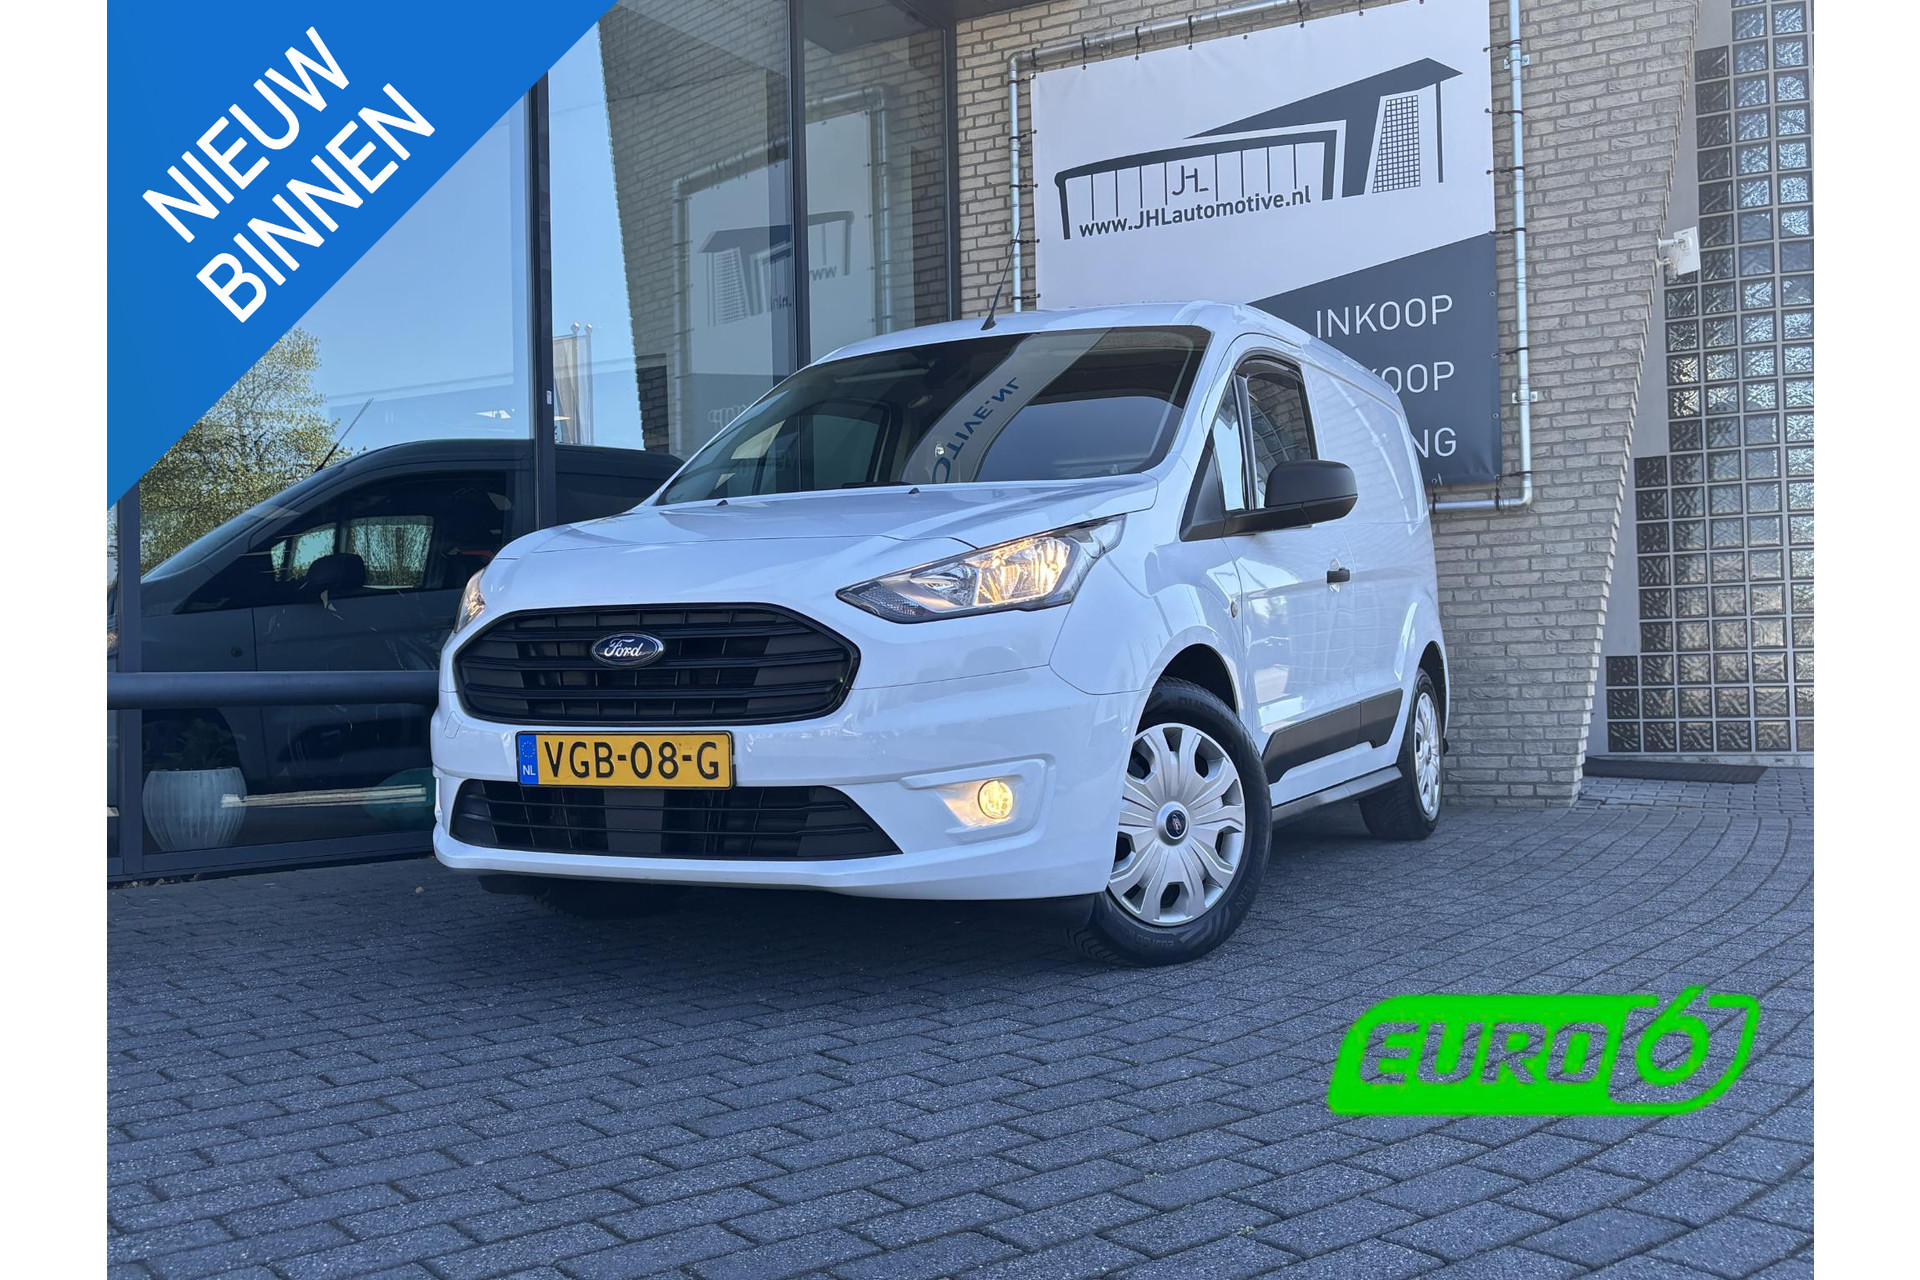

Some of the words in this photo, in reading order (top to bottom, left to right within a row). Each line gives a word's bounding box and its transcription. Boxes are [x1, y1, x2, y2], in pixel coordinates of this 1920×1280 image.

[1079, 185, 1312, 238] www.JHLautomotive.nl
[1316, 294, 1453, 339] INKOOP
[1371, 361, 1455, 394] OOP
[604, 638, 647, 657] Ford
[522, 764, 536, 776] NL
[544, 741, 720, 780] VGB-08-G
